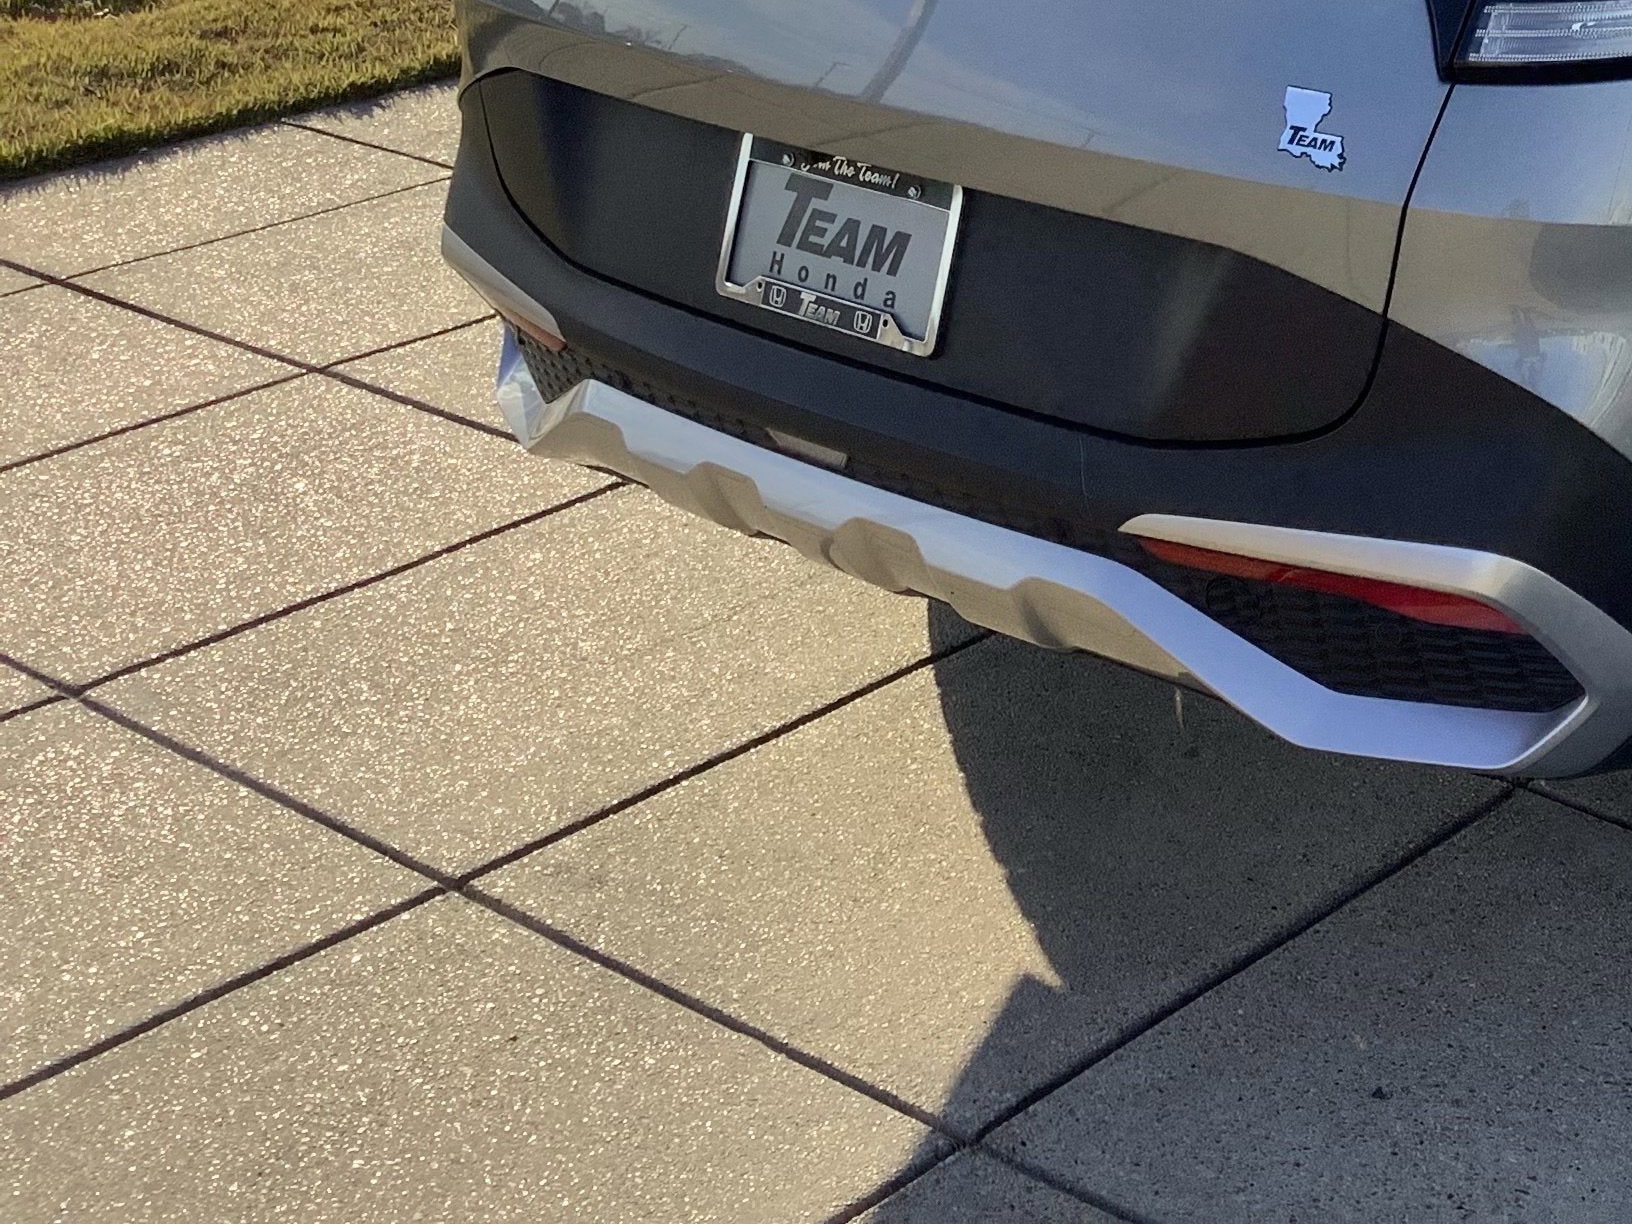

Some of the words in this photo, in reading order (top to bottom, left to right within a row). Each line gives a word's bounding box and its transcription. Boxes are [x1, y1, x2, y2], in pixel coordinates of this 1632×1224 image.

[1287, 125, 1336, 152] TEAM
[776, 172, 912, 277] TEAM
[769, 251, 896, 309] Honda
[798, 291, 841, 326] TEAM
